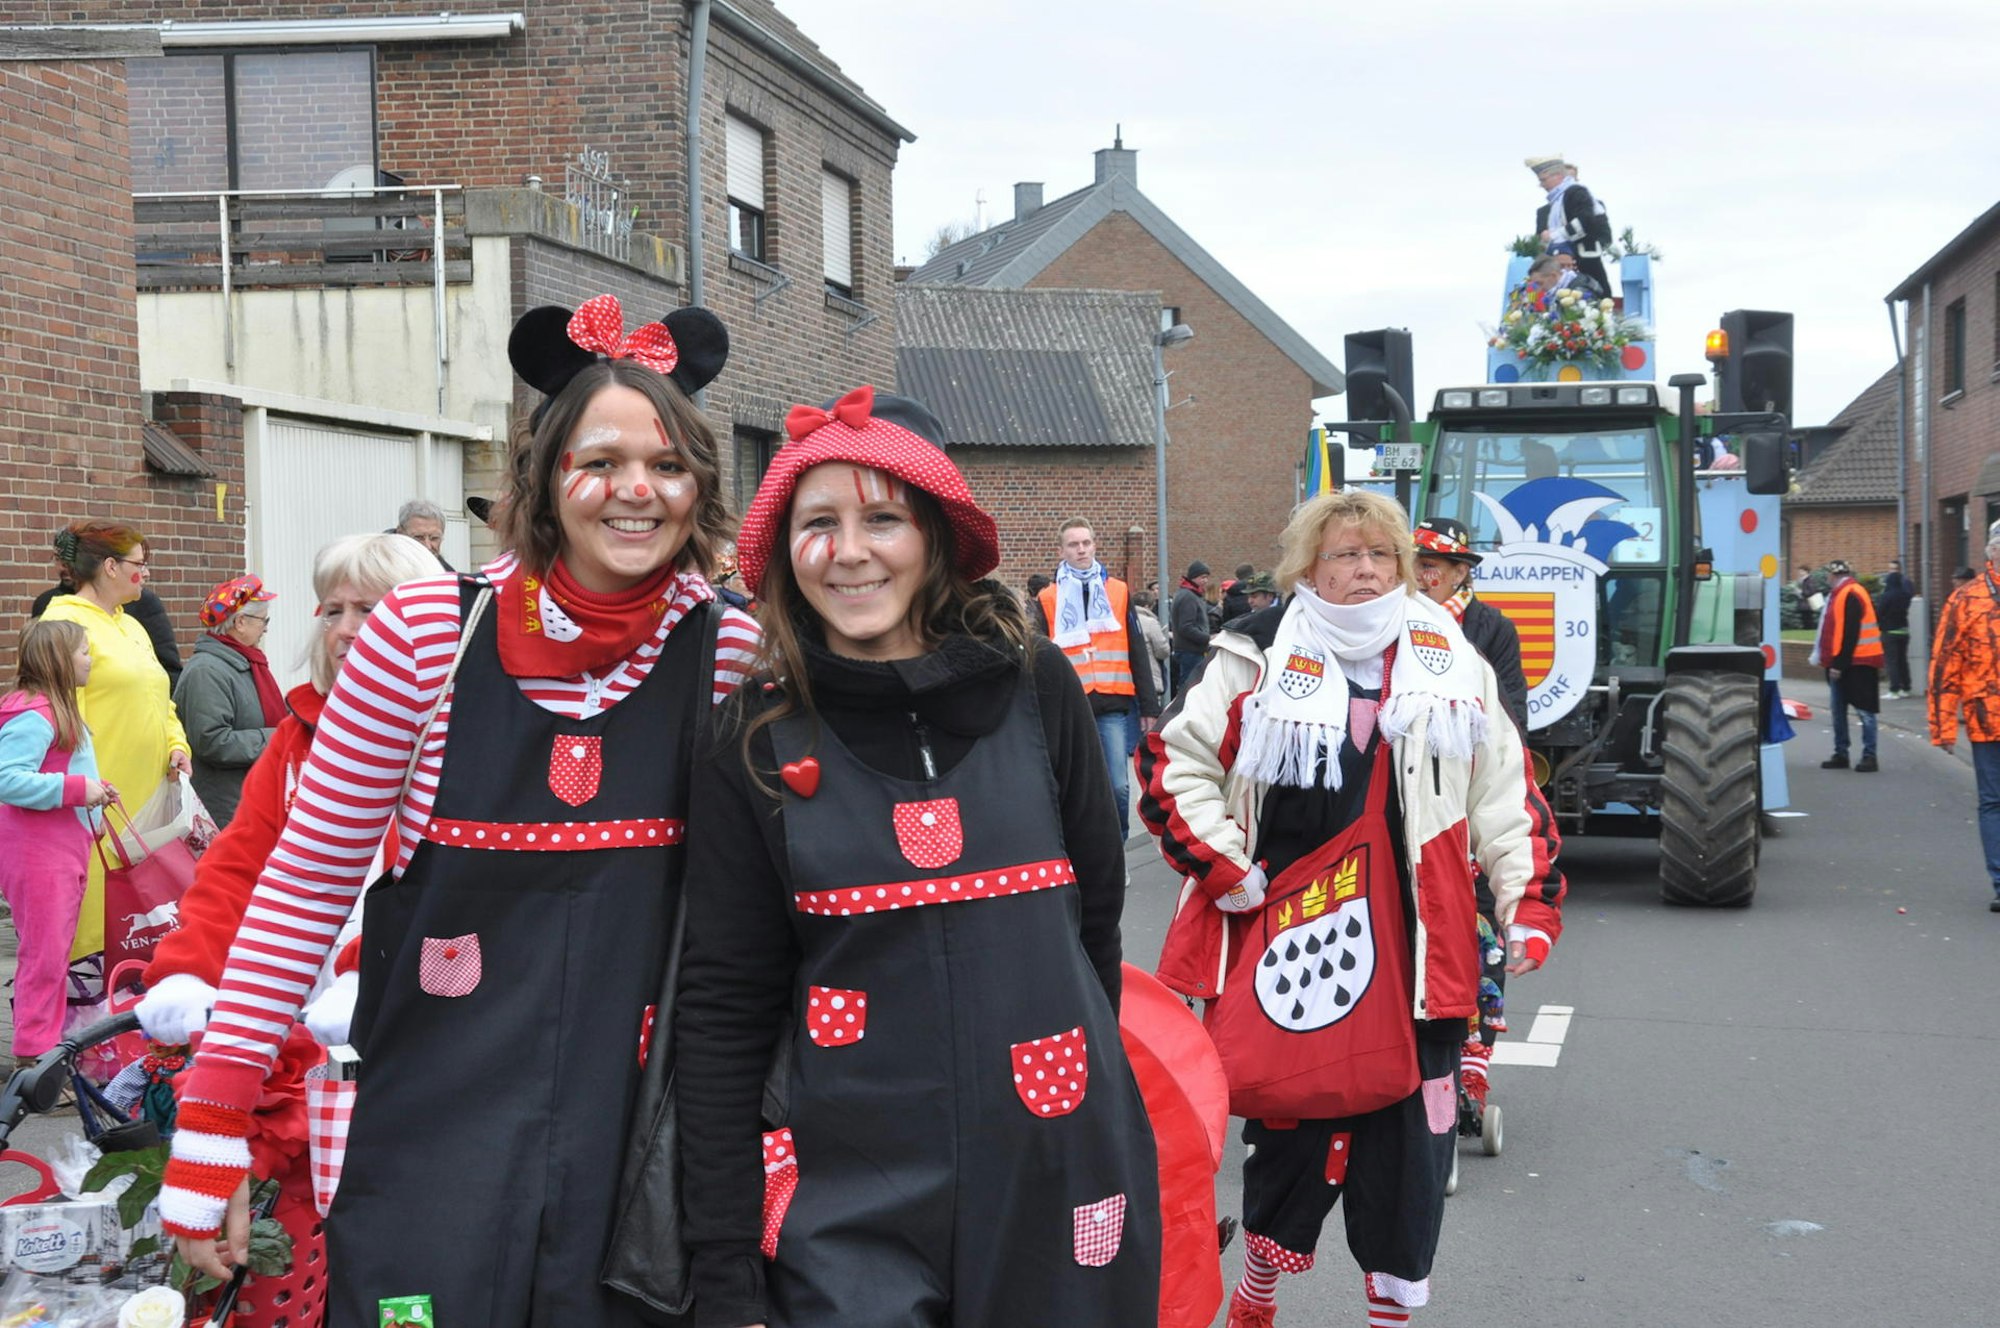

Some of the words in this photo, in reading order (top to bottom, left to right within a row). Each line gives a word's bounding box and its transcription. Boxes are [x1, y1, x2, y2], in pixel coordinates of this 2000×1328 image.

[1385, 446, 1400, 457] BM
[1383, 457, 1398, 468] GE
[1401, 457, 1416, 468] 62
[1469, 565, 1586, 581] BLAUKAPPEN
[1564, 620, 1589, 637] 30
[1527, 674, 1571, 714] DORF
[16, 1232, 65, 1257] Kokett
